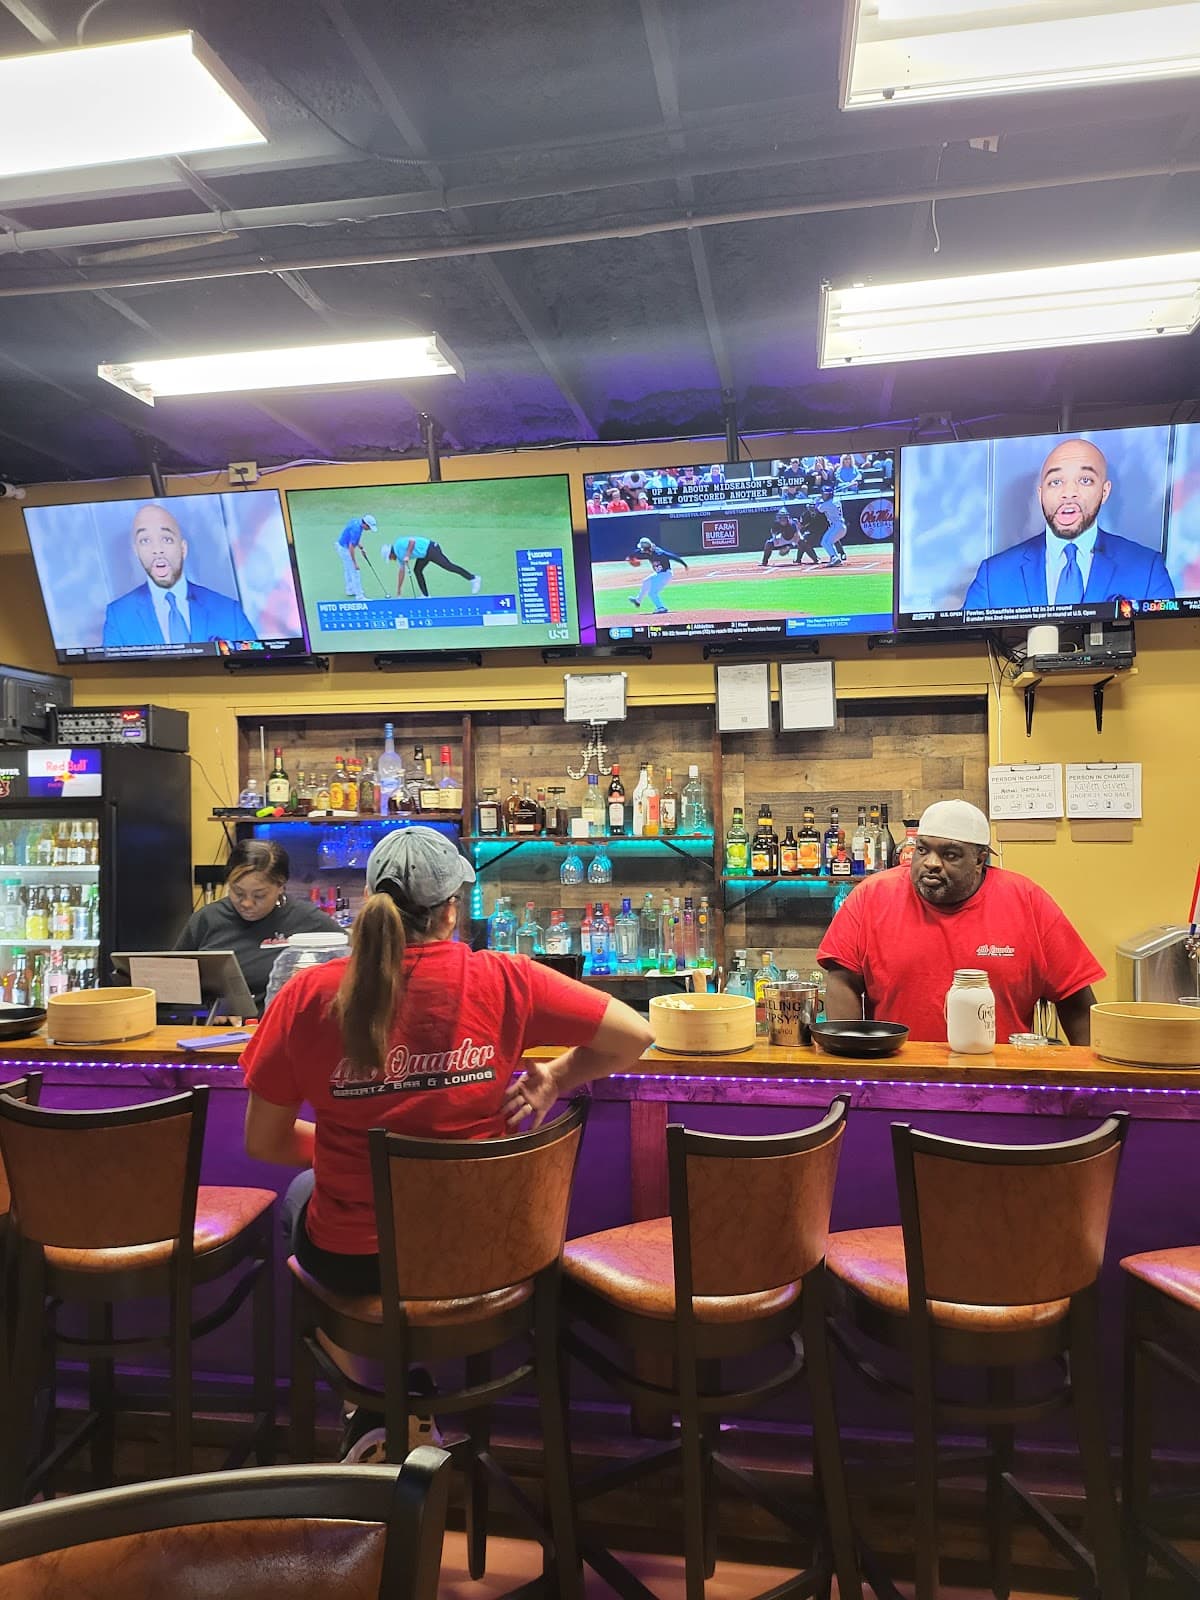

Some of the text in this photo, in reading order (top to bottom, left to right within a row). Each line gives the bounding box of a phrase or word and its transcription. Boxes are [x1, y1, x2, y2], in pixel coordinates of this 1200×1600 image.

[652, 478, 808, 496] UP AT ABOUT MIDSEASON'S SLUMP.
[652, 489, 768, 504] THEY OUTSCORED ANOTHER
[706, 531, 735, 539] BUREAU
[340, 603, 368, 611] PEREIRA
[500, 598, 511, 608] +1
[46, 759, 87, 772] Red Bull
[384, 1038, 494, 1084] Quarter
